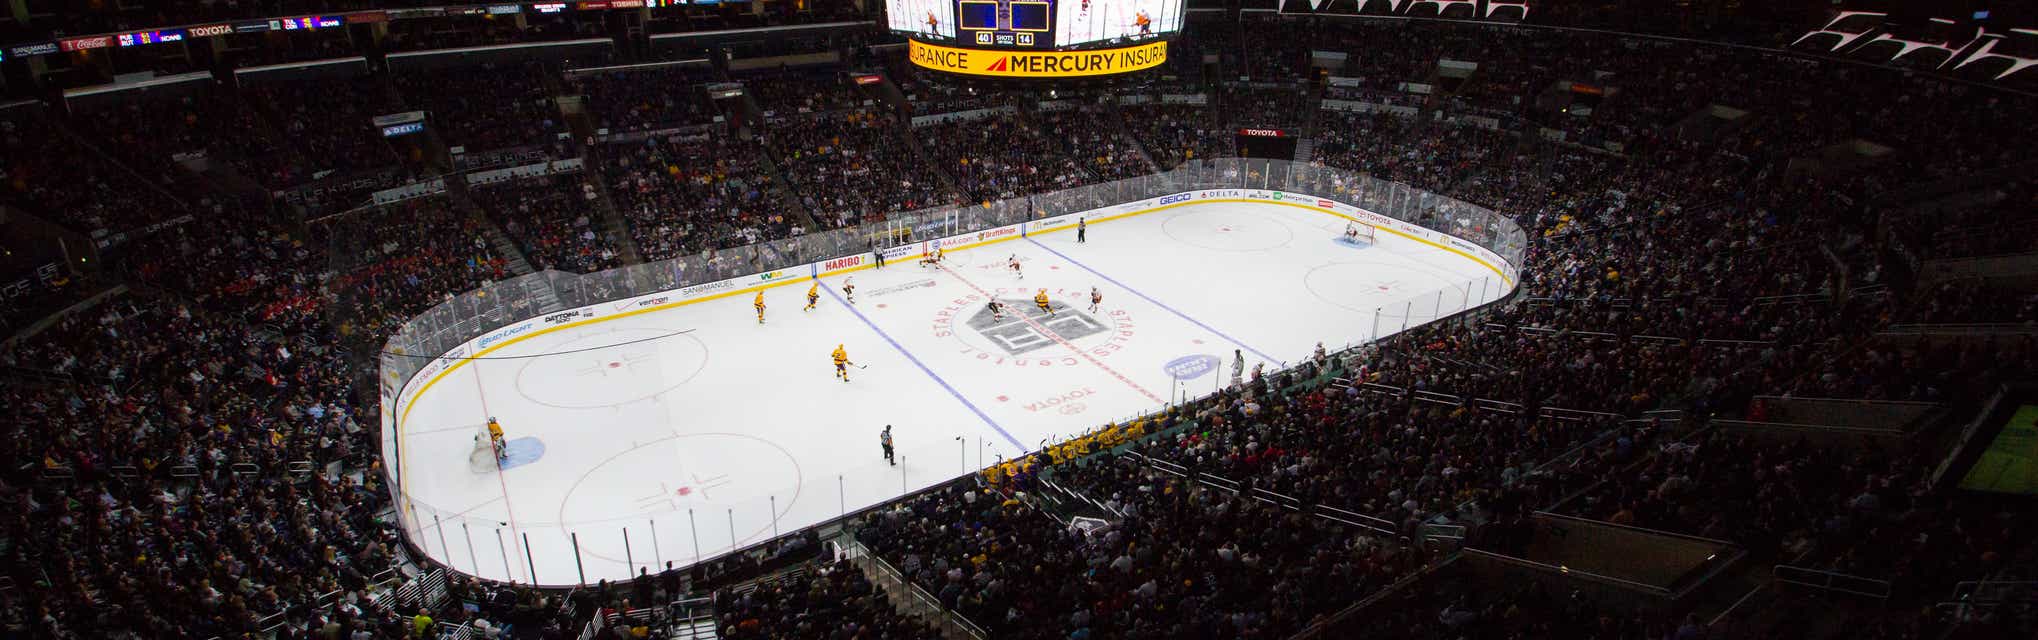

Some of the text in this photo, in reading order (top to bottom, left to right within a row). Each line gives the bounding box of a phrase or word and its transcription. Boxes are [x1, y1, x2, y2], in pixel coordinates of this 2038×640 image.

[191, 24, 233, 38] TOYOTA
[978, 34, 989, 42] 40
[1012, 53, 1116, 73] MERCURY
[393, 121, 424, 134] DELTA
[1247, 129, 1277, 137] TOYOTA
[1160, 193, 1191, 205] GEICO
[1209, 191, 1240, 199] DELTA
[1366, 213, 1393, 226] TOYOTA
[985, 227, 1016, 238] DraftKings
[942, 236, 973, 248] AAA.com
[881, 245, 912, 255] MERICAN
[825, 256, 860, 271] HARIBO
[682, 279, 735, 296] SAN MANUEL
[638, 296, 669, 307] verizon
[545, 310, 579, 323] DAYTONA
[481, 323, 534, 346] BUD LIGHT
